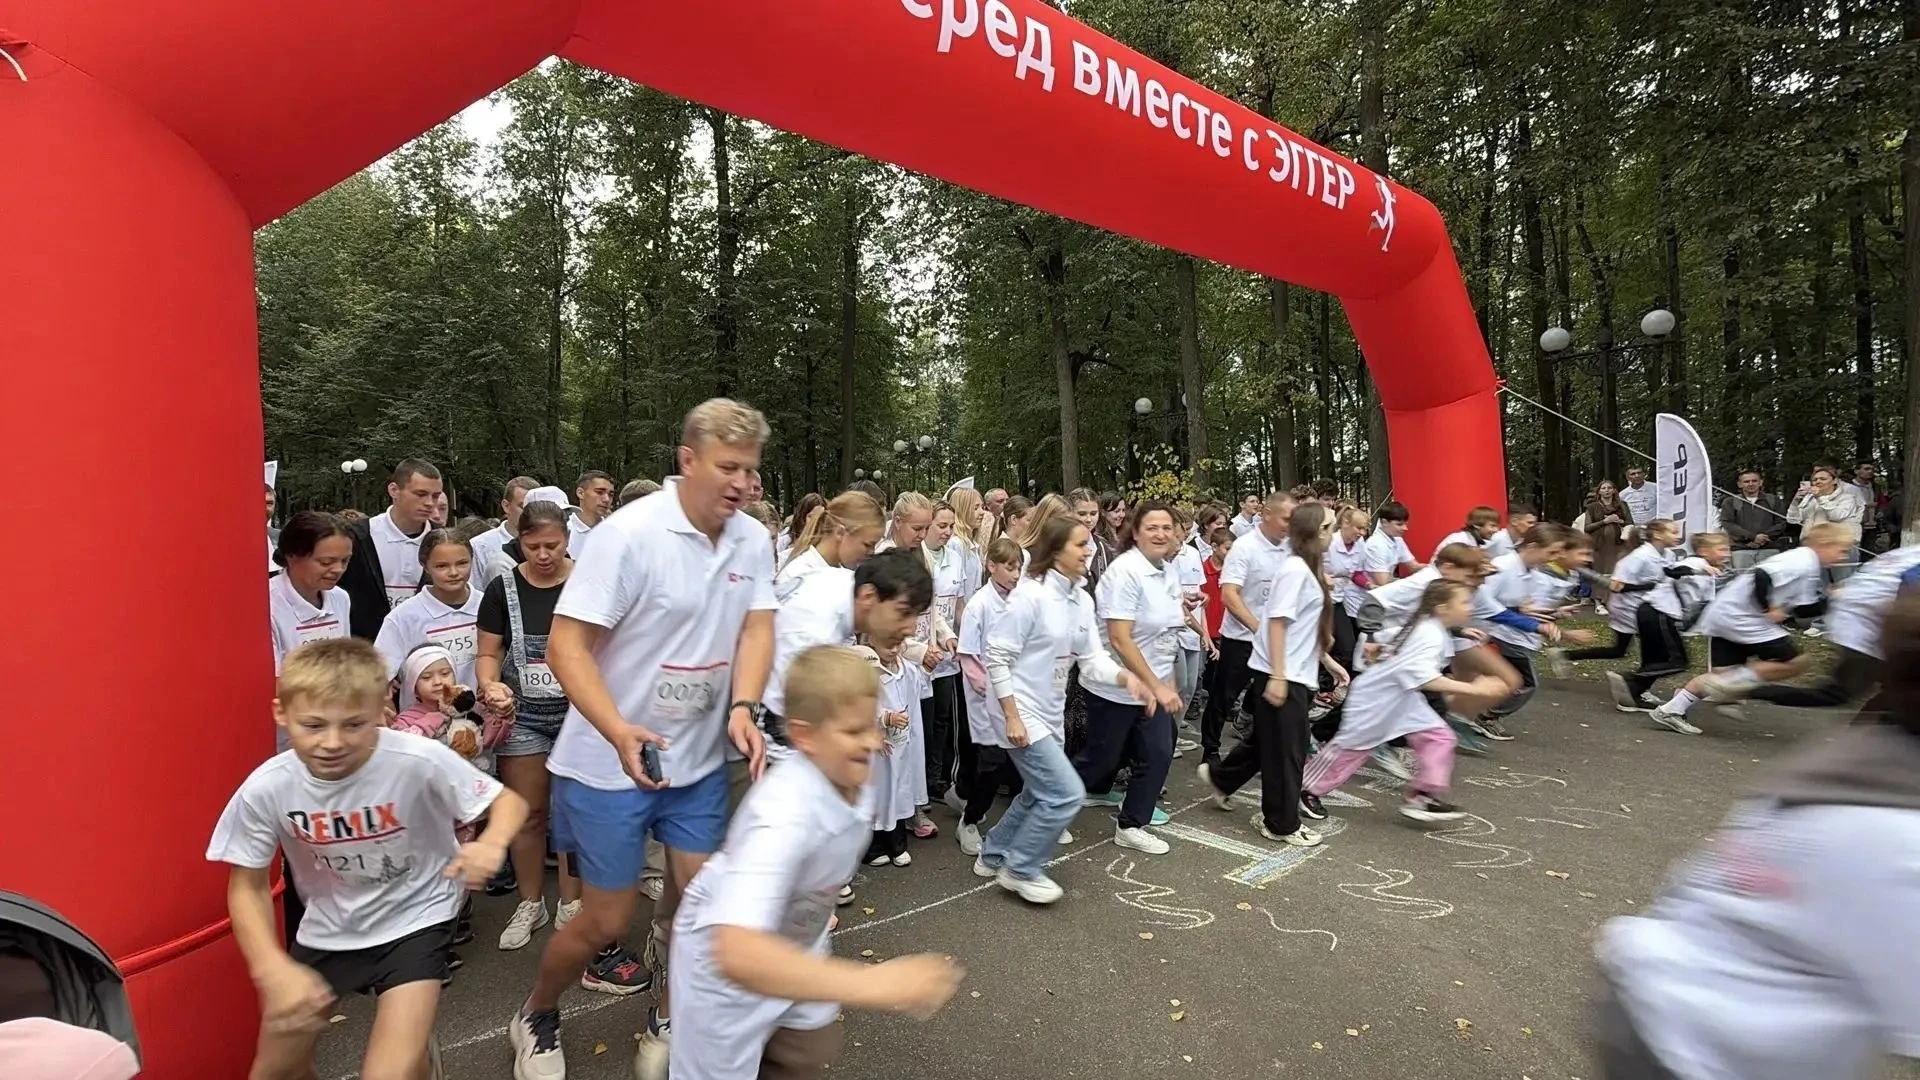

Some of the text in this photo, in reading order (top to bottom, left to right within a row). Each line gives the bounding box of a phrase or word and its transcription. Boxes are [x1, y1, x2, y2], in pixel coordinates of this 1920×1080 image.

[1072, 40, 1232, 157] вместе
[1243, 128, 1260, 170] с
[1266, 129, 1355, 210] ЭГГЕР
[524, 672, 558, 686] 180
